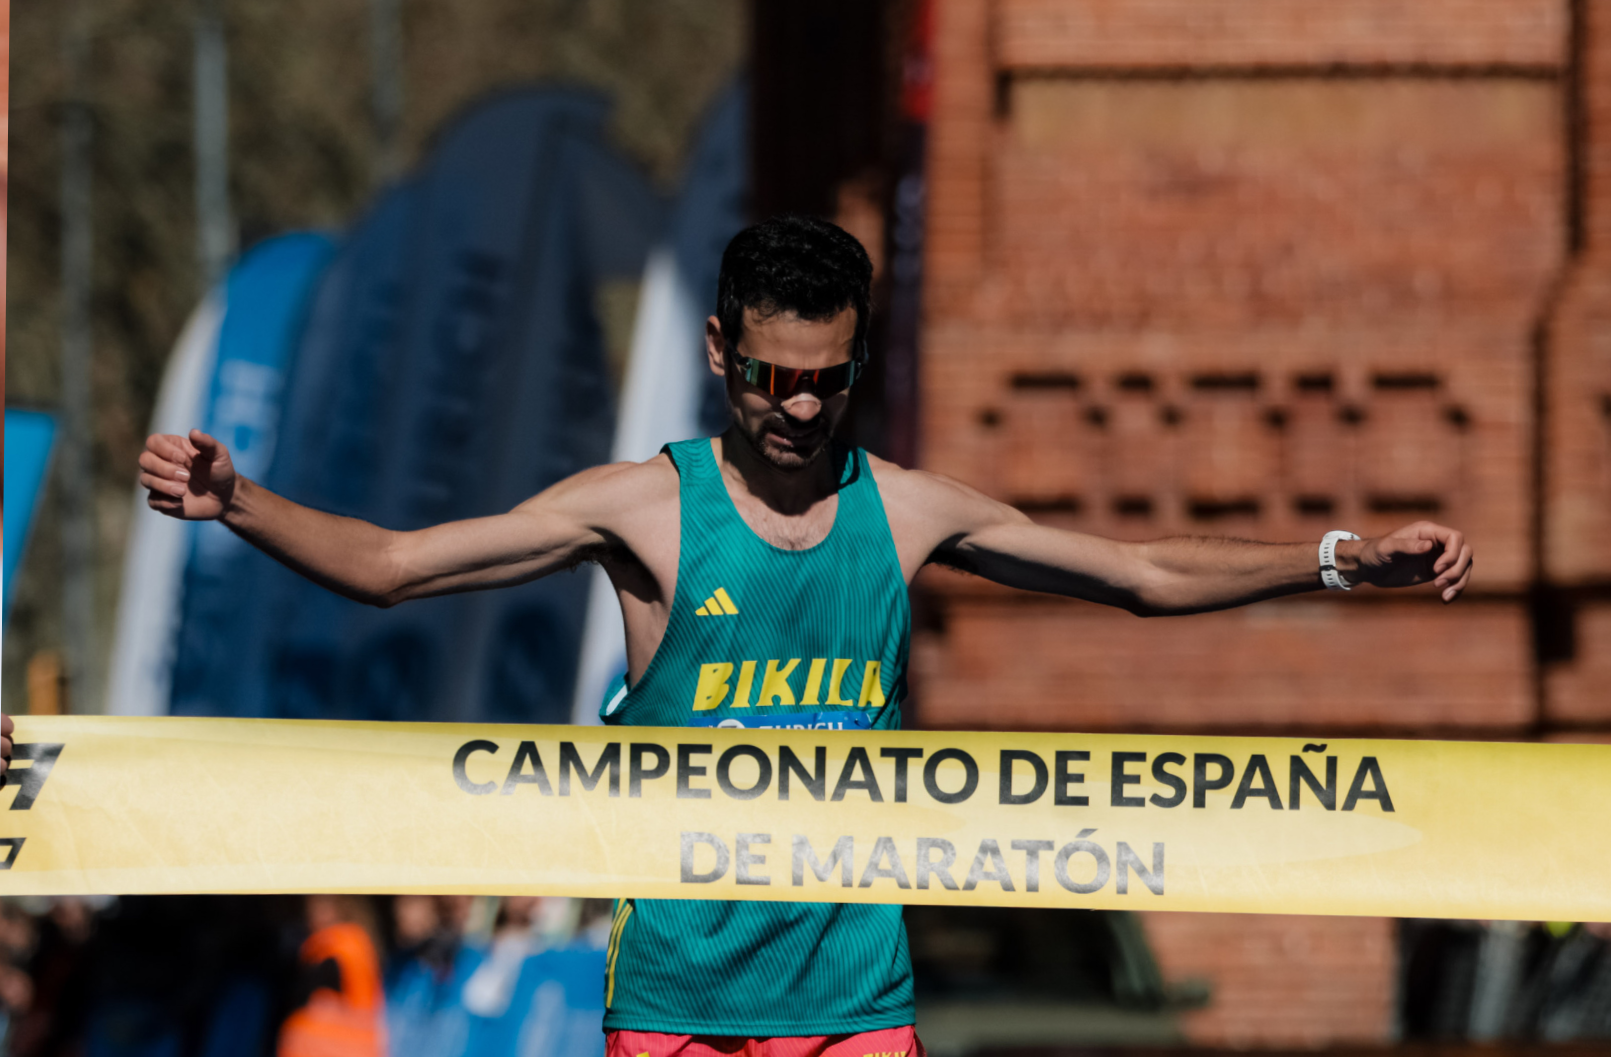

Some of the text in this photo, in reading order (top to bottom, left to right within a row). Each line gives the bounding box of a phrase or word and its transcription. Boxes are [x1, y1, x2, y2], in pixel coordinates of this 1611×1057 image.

[451, 739, 1396, 813] CAMPEONATO DE ESPAÑA
[679, 828, 1166, 896] DE MARATÓN
